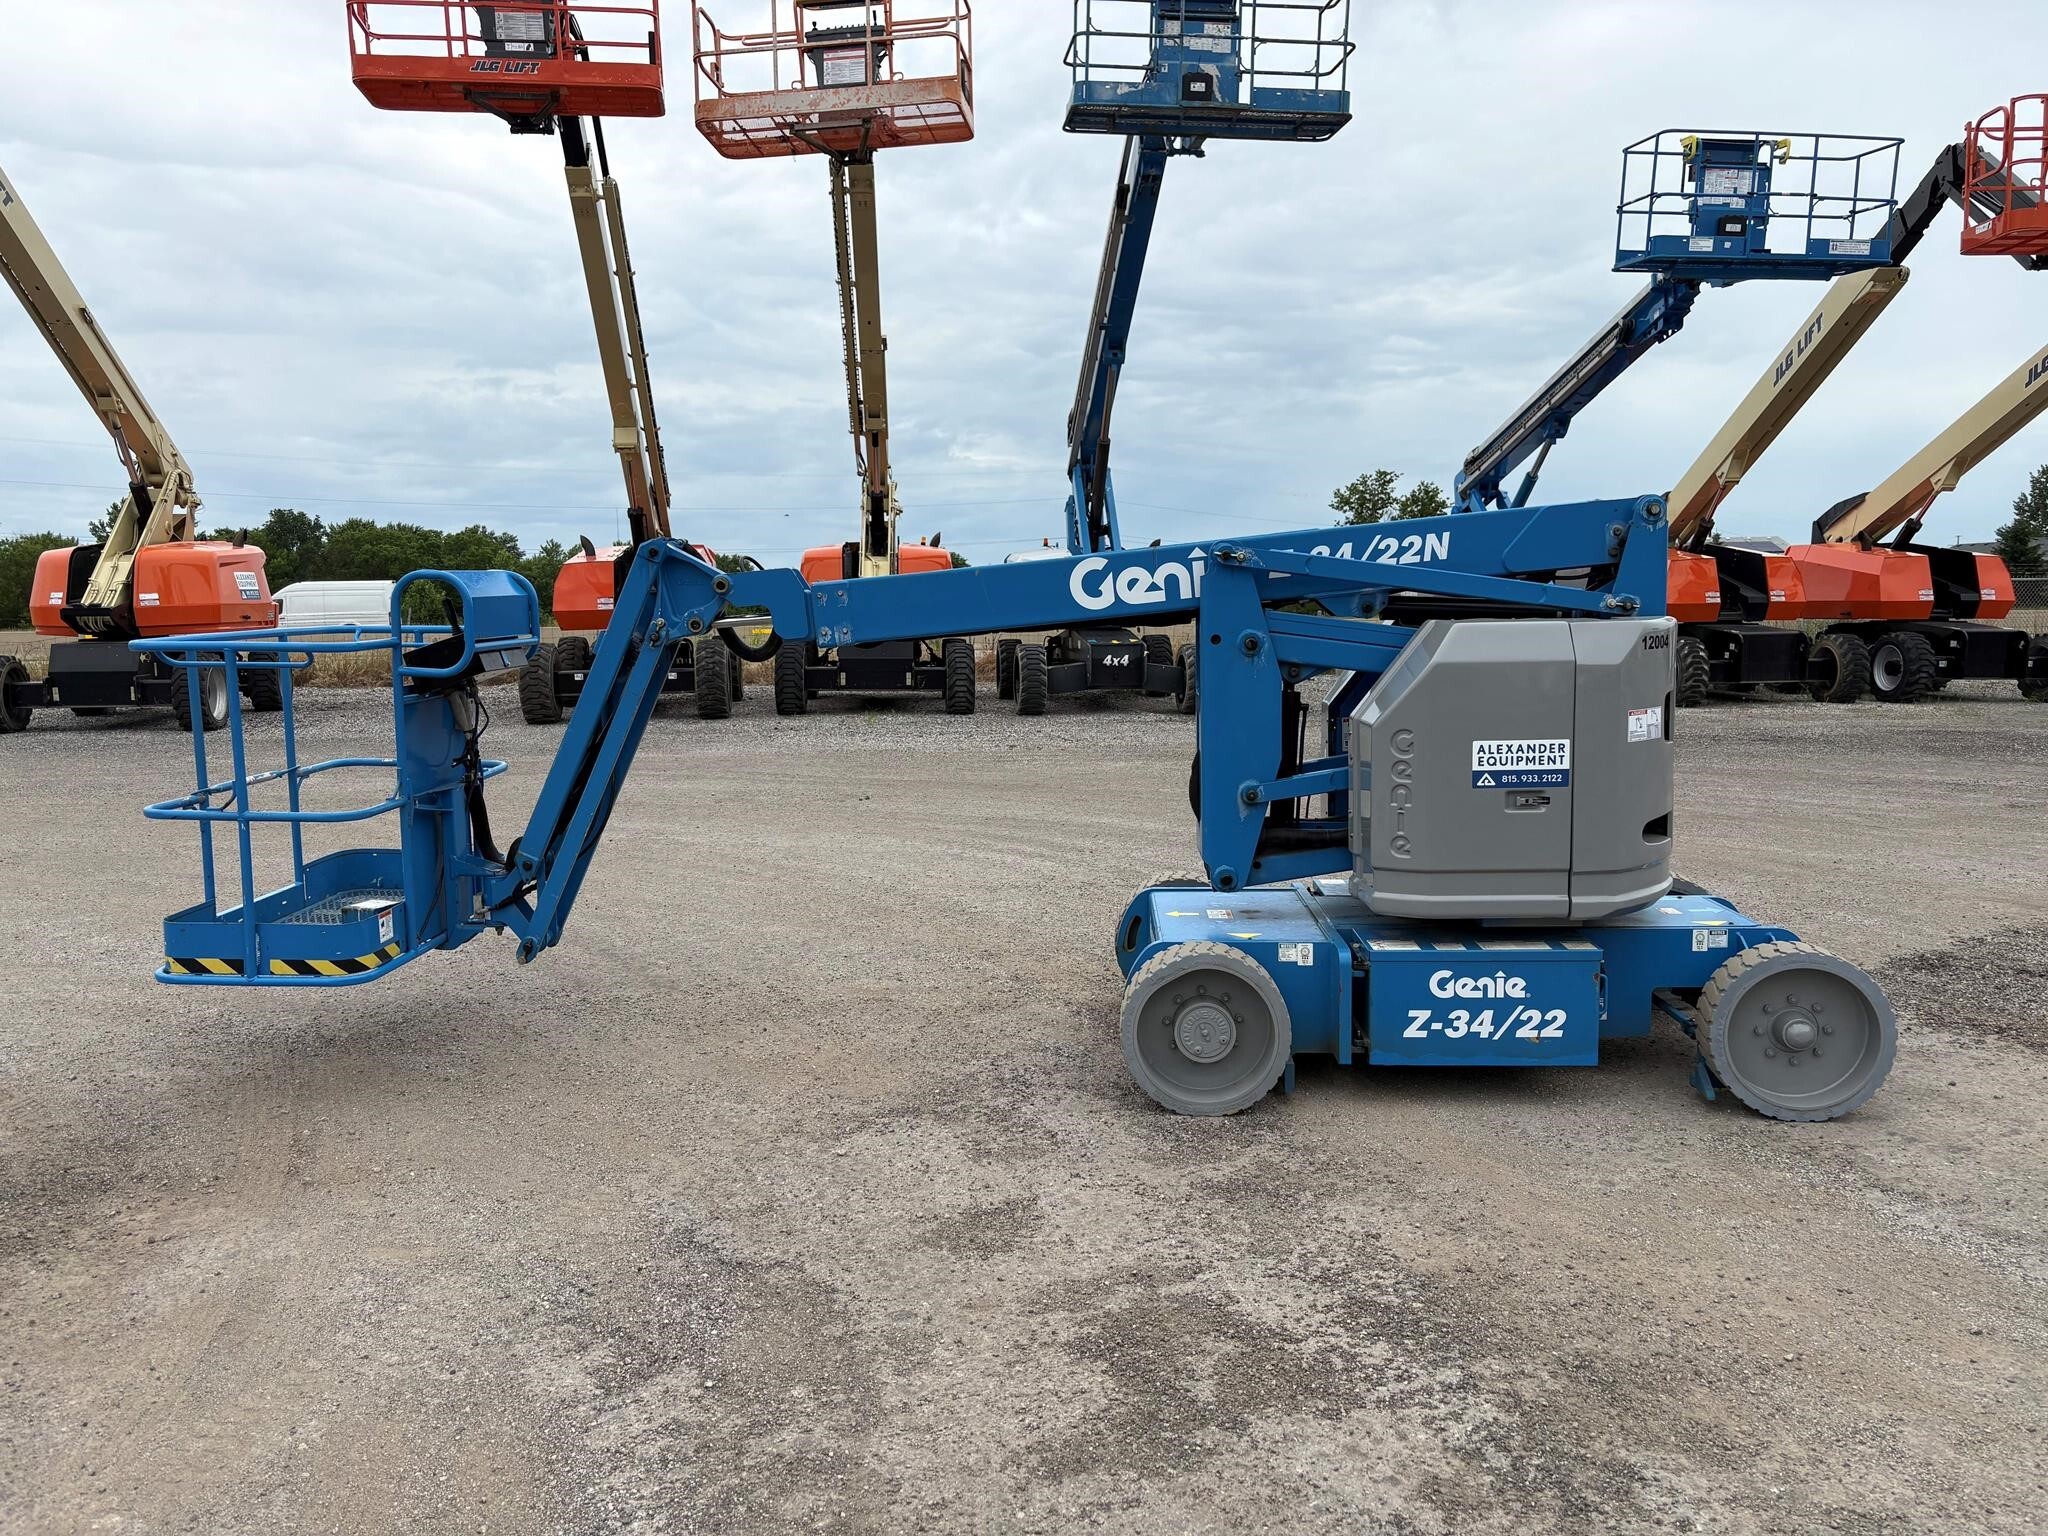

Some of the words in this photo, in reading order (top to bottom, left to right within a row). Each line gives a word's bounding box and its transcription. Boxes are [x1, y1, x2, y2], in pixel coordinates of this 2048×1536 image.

[469, 60, 502, 73] JLG
[503, 61, 541, 74] LIFT
[1773, 349, 1794, 388] JLG
[1797, 312, 1824, 358] LIFT
[1069, 547, 1207, 610] Geni
[1641, 634, 1669, 650] 12004
[1102, 654, 1130, 667] 4x4
[1477, 743, 1566, 755] ALEXANDER
[1478, 755, 1565, 766] EQUIPMENT
[1390, 728, 1414, 859] Genie
[1429, 969, 1527, 999] Genie
[1403, 1005, 1567, 1041] Z-34/22
